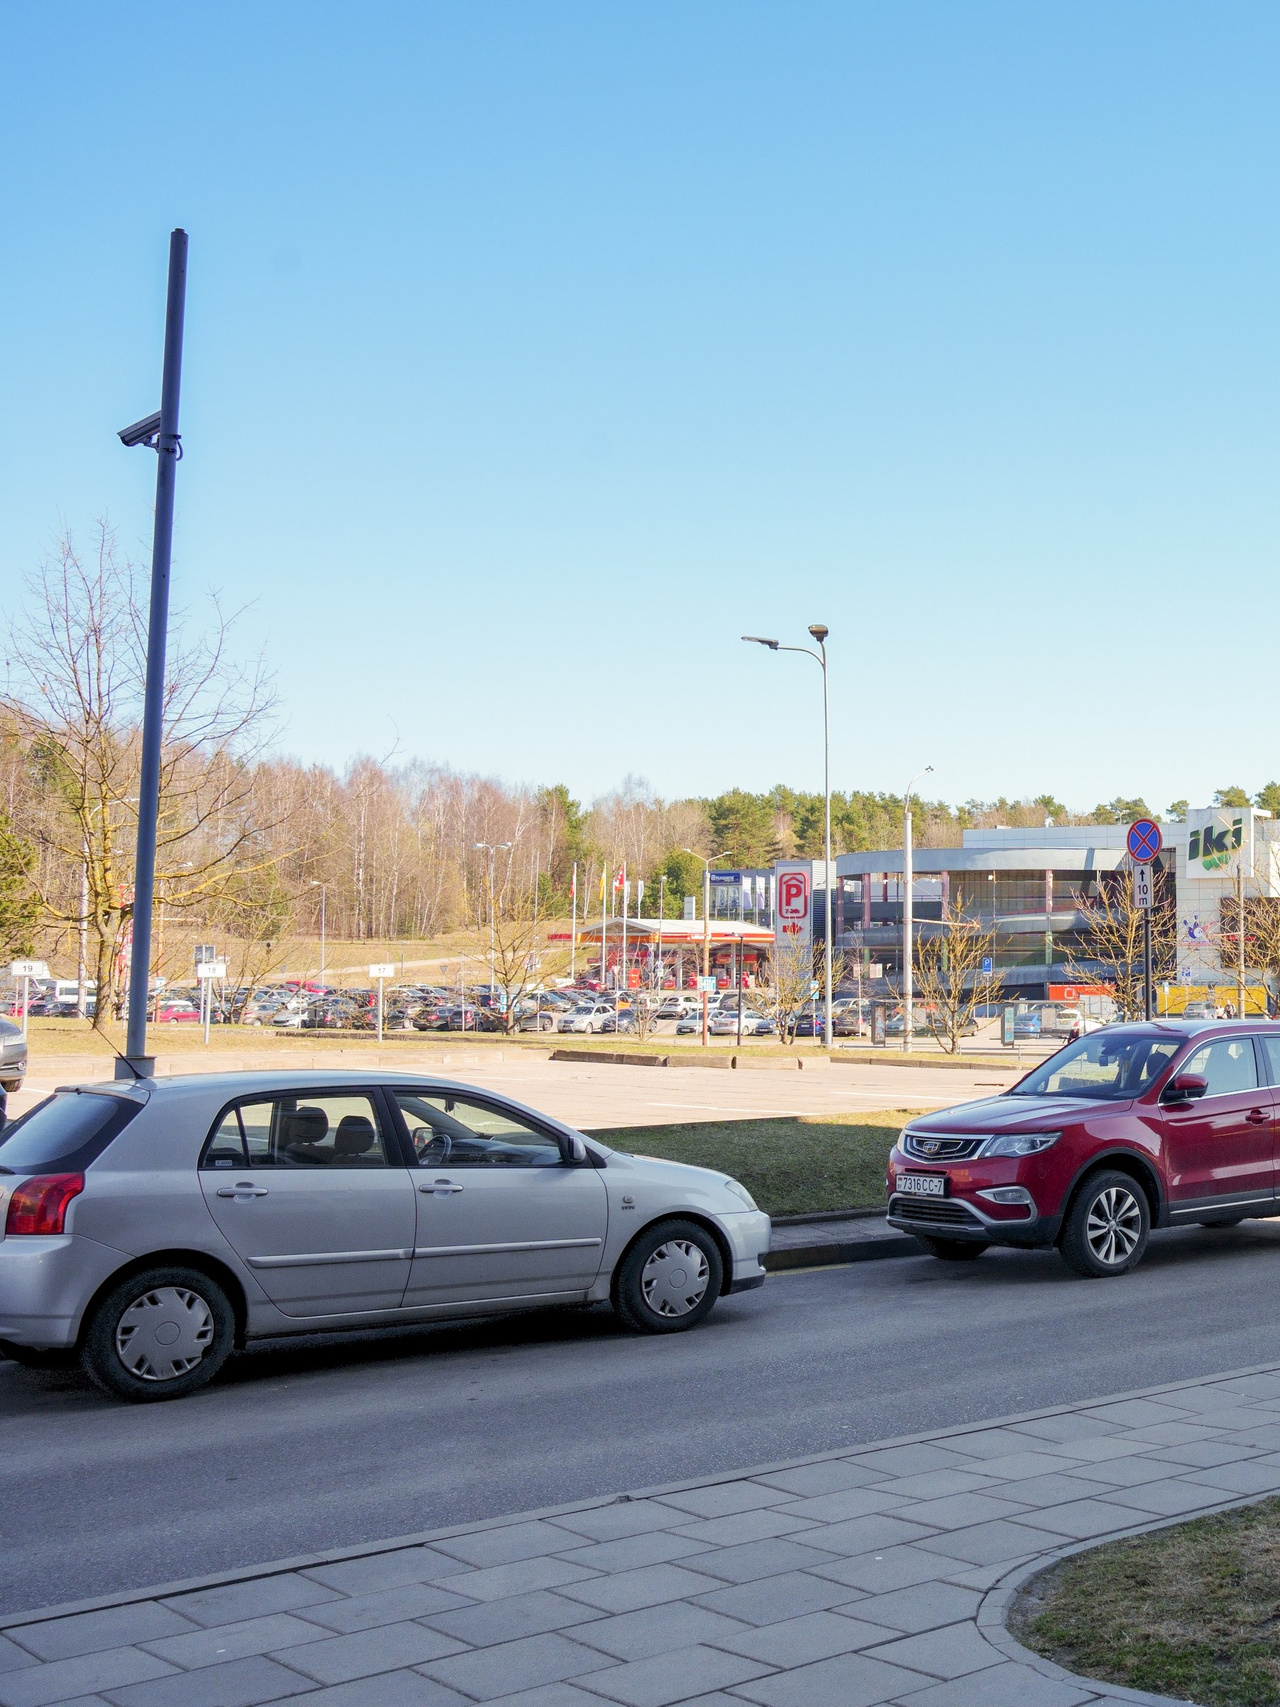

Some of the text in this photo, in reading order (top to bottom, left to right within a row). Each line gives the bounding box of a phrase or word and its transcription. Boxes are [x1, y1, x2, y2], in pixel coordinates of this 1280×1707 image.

[1188, 818, 1242, 860] iki
[785, 883, 802, 907] P
[1137, 884, 1149, 895] 10
[1138, 897, 1148, 905] m
